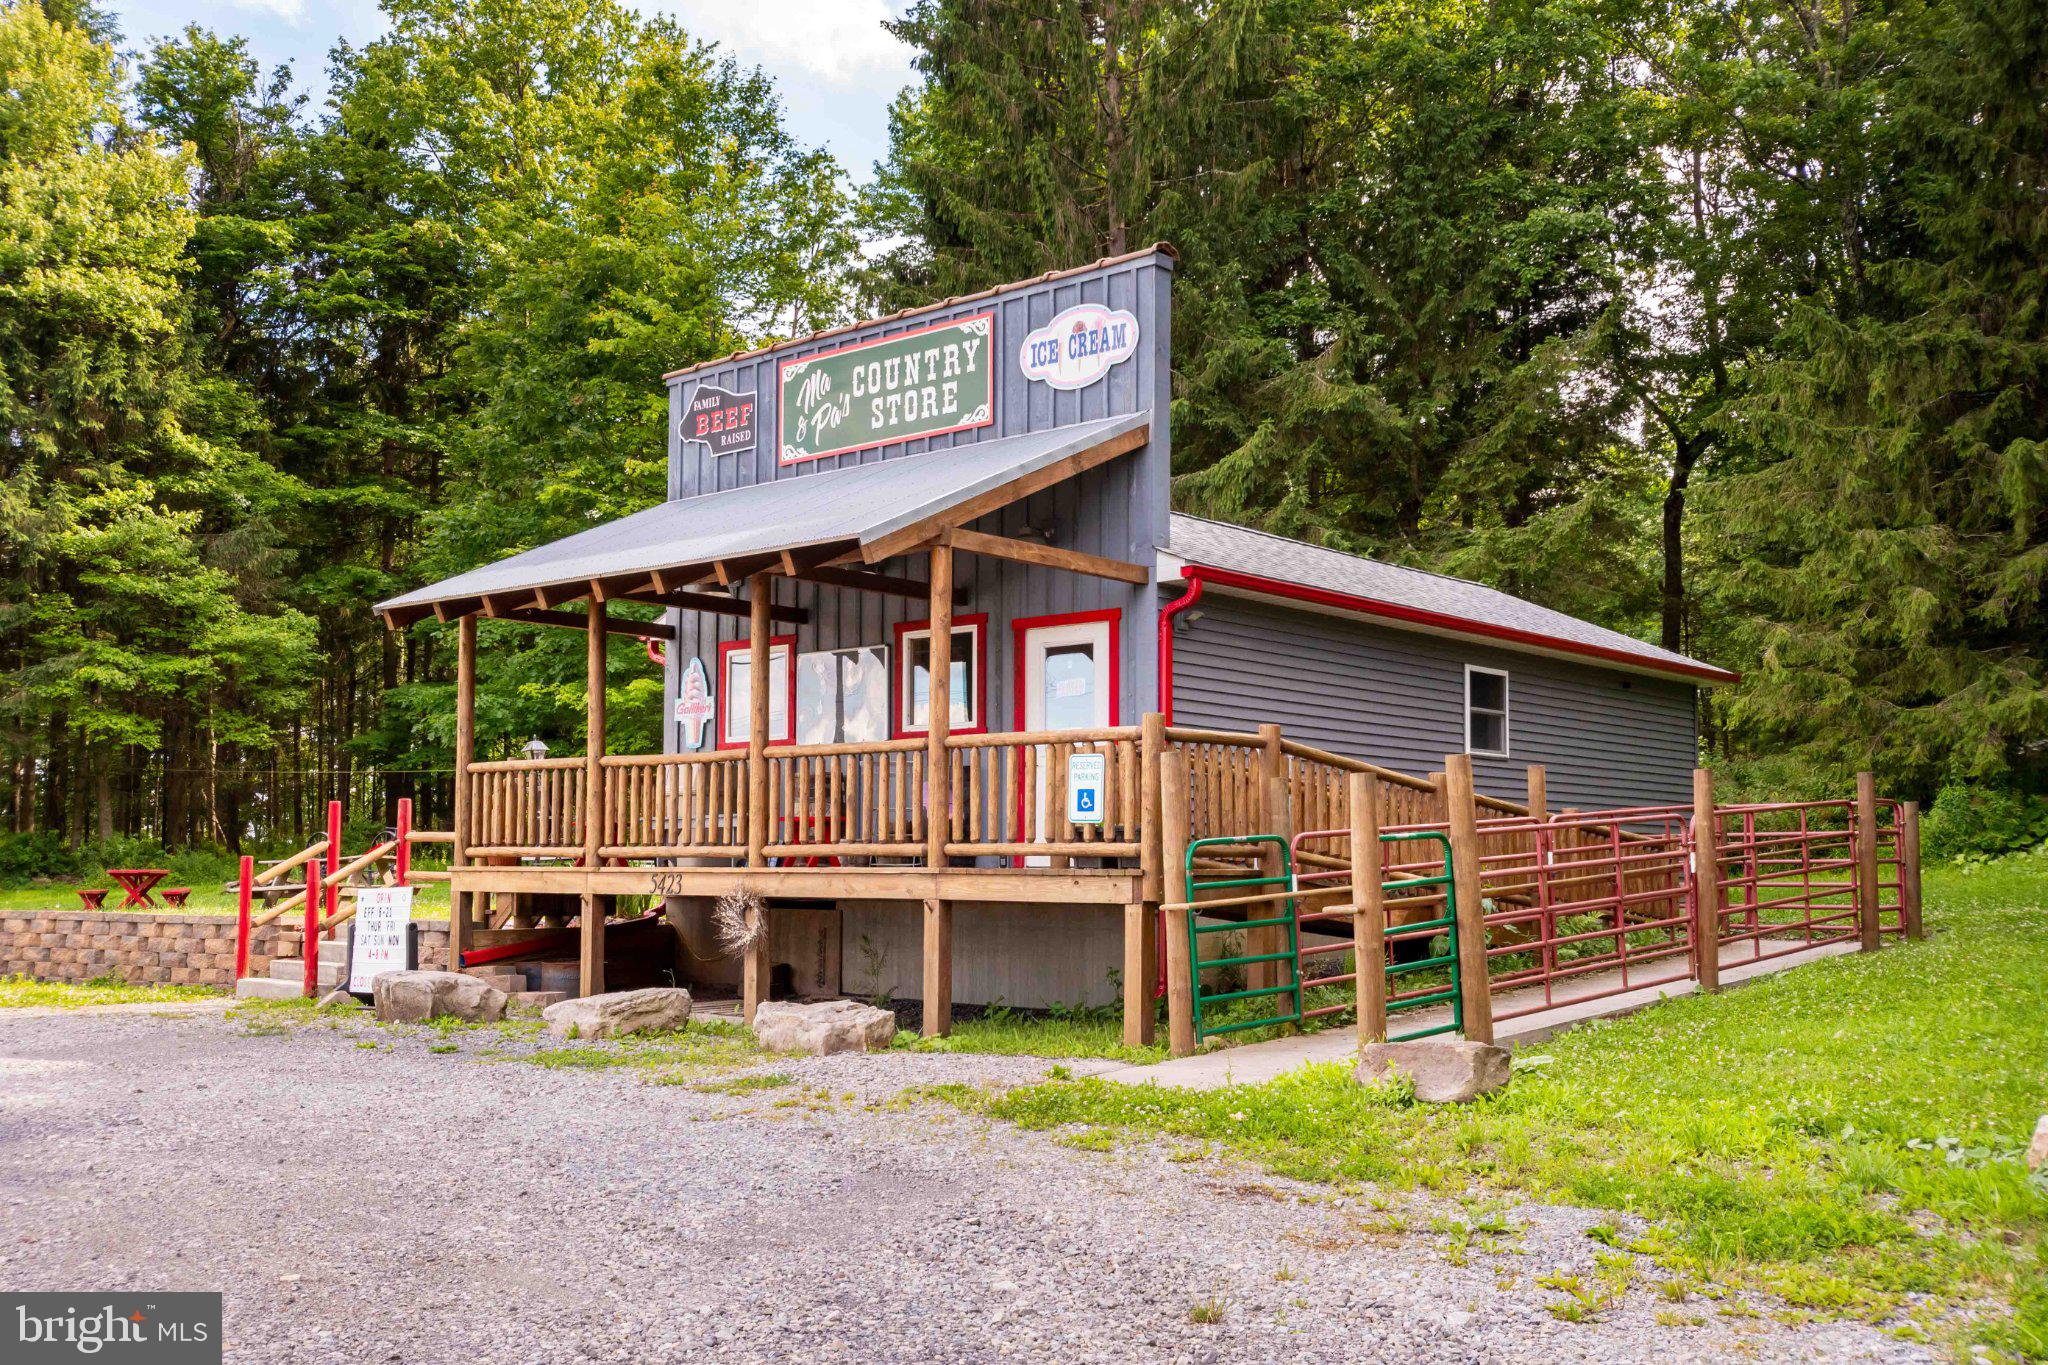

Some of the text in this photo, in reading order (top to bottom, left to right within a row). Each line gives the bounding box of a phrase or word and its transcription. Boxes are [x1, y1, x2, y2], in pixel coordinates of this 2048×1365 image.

[1031, 323, 1127, 368] ICE CREAM
[852, 338, 981, 398] COUNTRY
[796, 369, 832, 414] Ma
[693, 396, 721, 411] FAMILY
[871, 381, 958, 430] STORE
[695, 403, 753, 437] BEEF
[811, 393, 850, 446] Pa's
[721, 430, 751, 446] RAISED
[1072, 761, 1102, 770] RESERVED
[1073, 772, 1100, 781] PARKING
[649, 872, 683, 895] 5423
[386, 921, 396, 932] FRI
[360, 935, 371, 946] SAT
[374, 935, 385, 946] SUN
